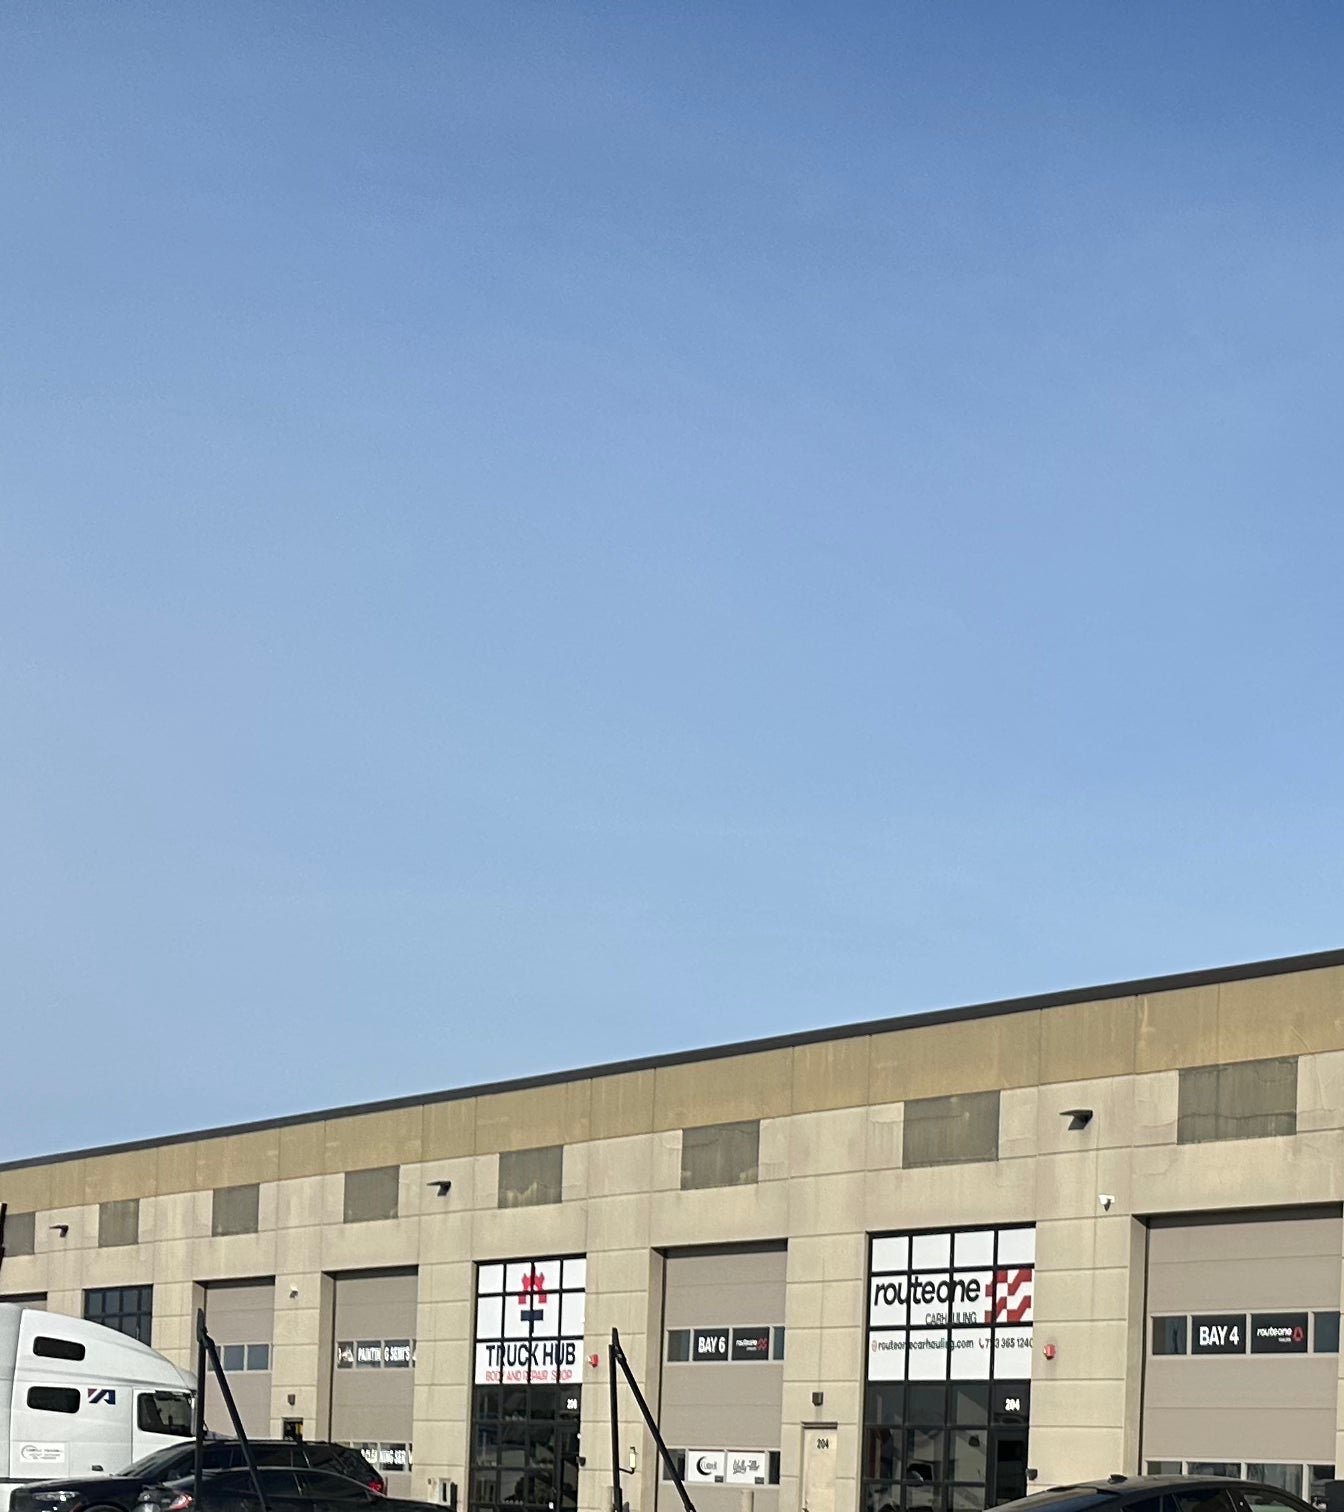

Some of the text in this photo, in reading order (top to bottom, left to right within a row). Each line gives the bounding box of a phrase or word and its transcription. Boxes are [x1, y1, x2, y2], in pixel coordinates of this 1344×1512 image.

[874, 1276, 981, 1306] routeone
[925, 1311, 977, 1326] CARHULING
[1199, 1325, 1240, 1346] BAY 4
[1256, 1326, 1293, 1337] routeone
[697, 1336, 726, 1353] BAY 6
[486, 1342, 576, 1367] TRUCK HUB
[523, 1369, 549, 1381] RPAIR
[551, 1369, 573, 1381] SOP
